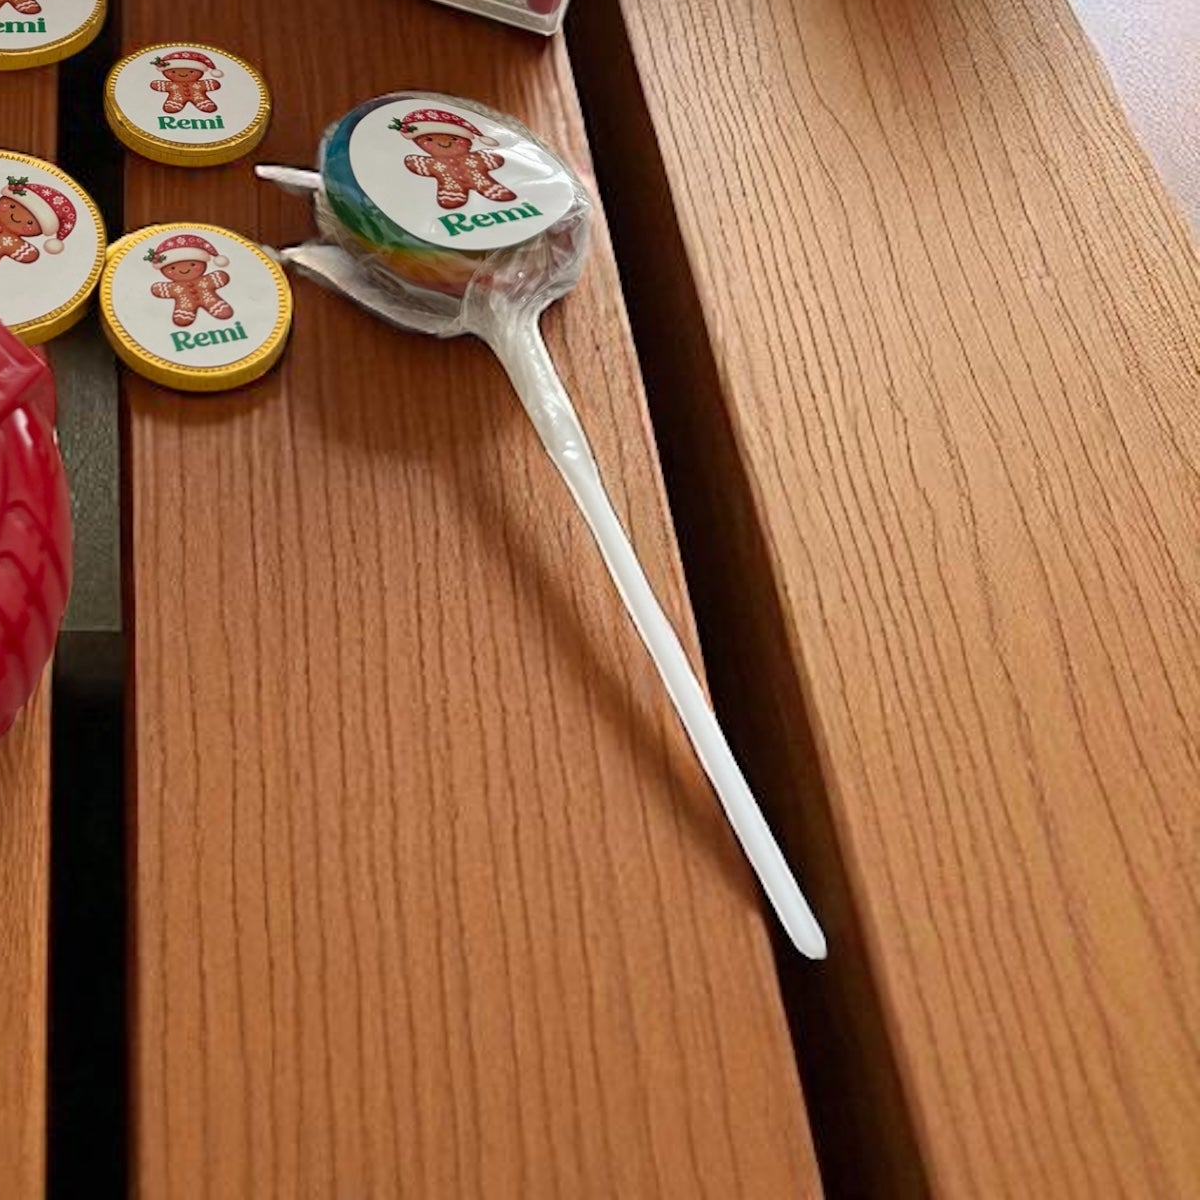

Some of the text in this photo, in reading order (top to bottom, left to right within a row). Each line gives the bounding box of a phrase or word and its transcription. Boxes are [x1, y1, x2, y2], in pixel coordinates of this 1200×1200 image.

[158, 115, 225, 131] Remi
[438, 201, 543, 237] Remi
[170, 320, 248, 352] Remi
